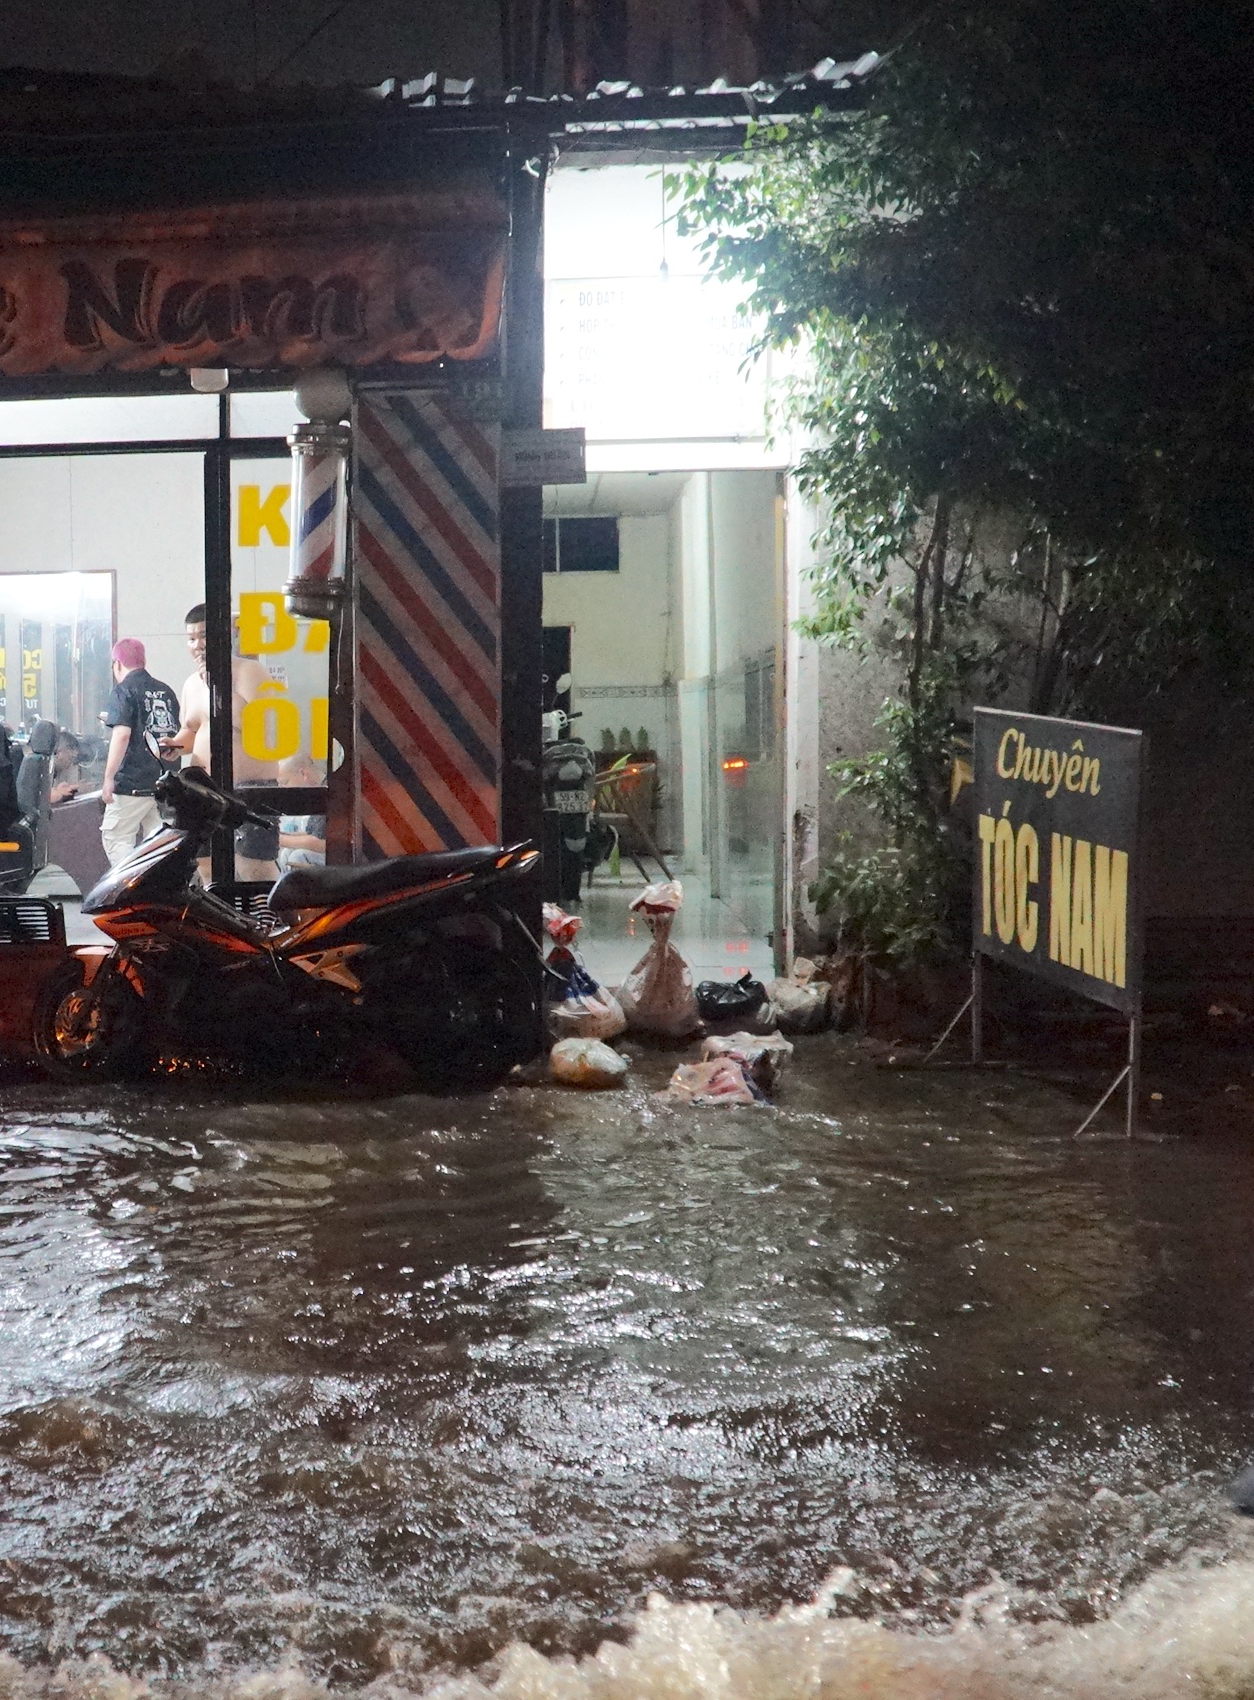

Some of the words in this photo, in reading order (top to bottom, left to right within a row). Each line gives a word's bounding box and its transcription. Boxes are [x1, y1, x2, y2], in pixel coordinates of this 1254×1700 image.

[59, 257, 365, 352] Nam
[997, 727, 1101, 798] Chuyên
[979, 800, 1039, 953] TÓC
[1049, 832, 1129, 989] NAM
